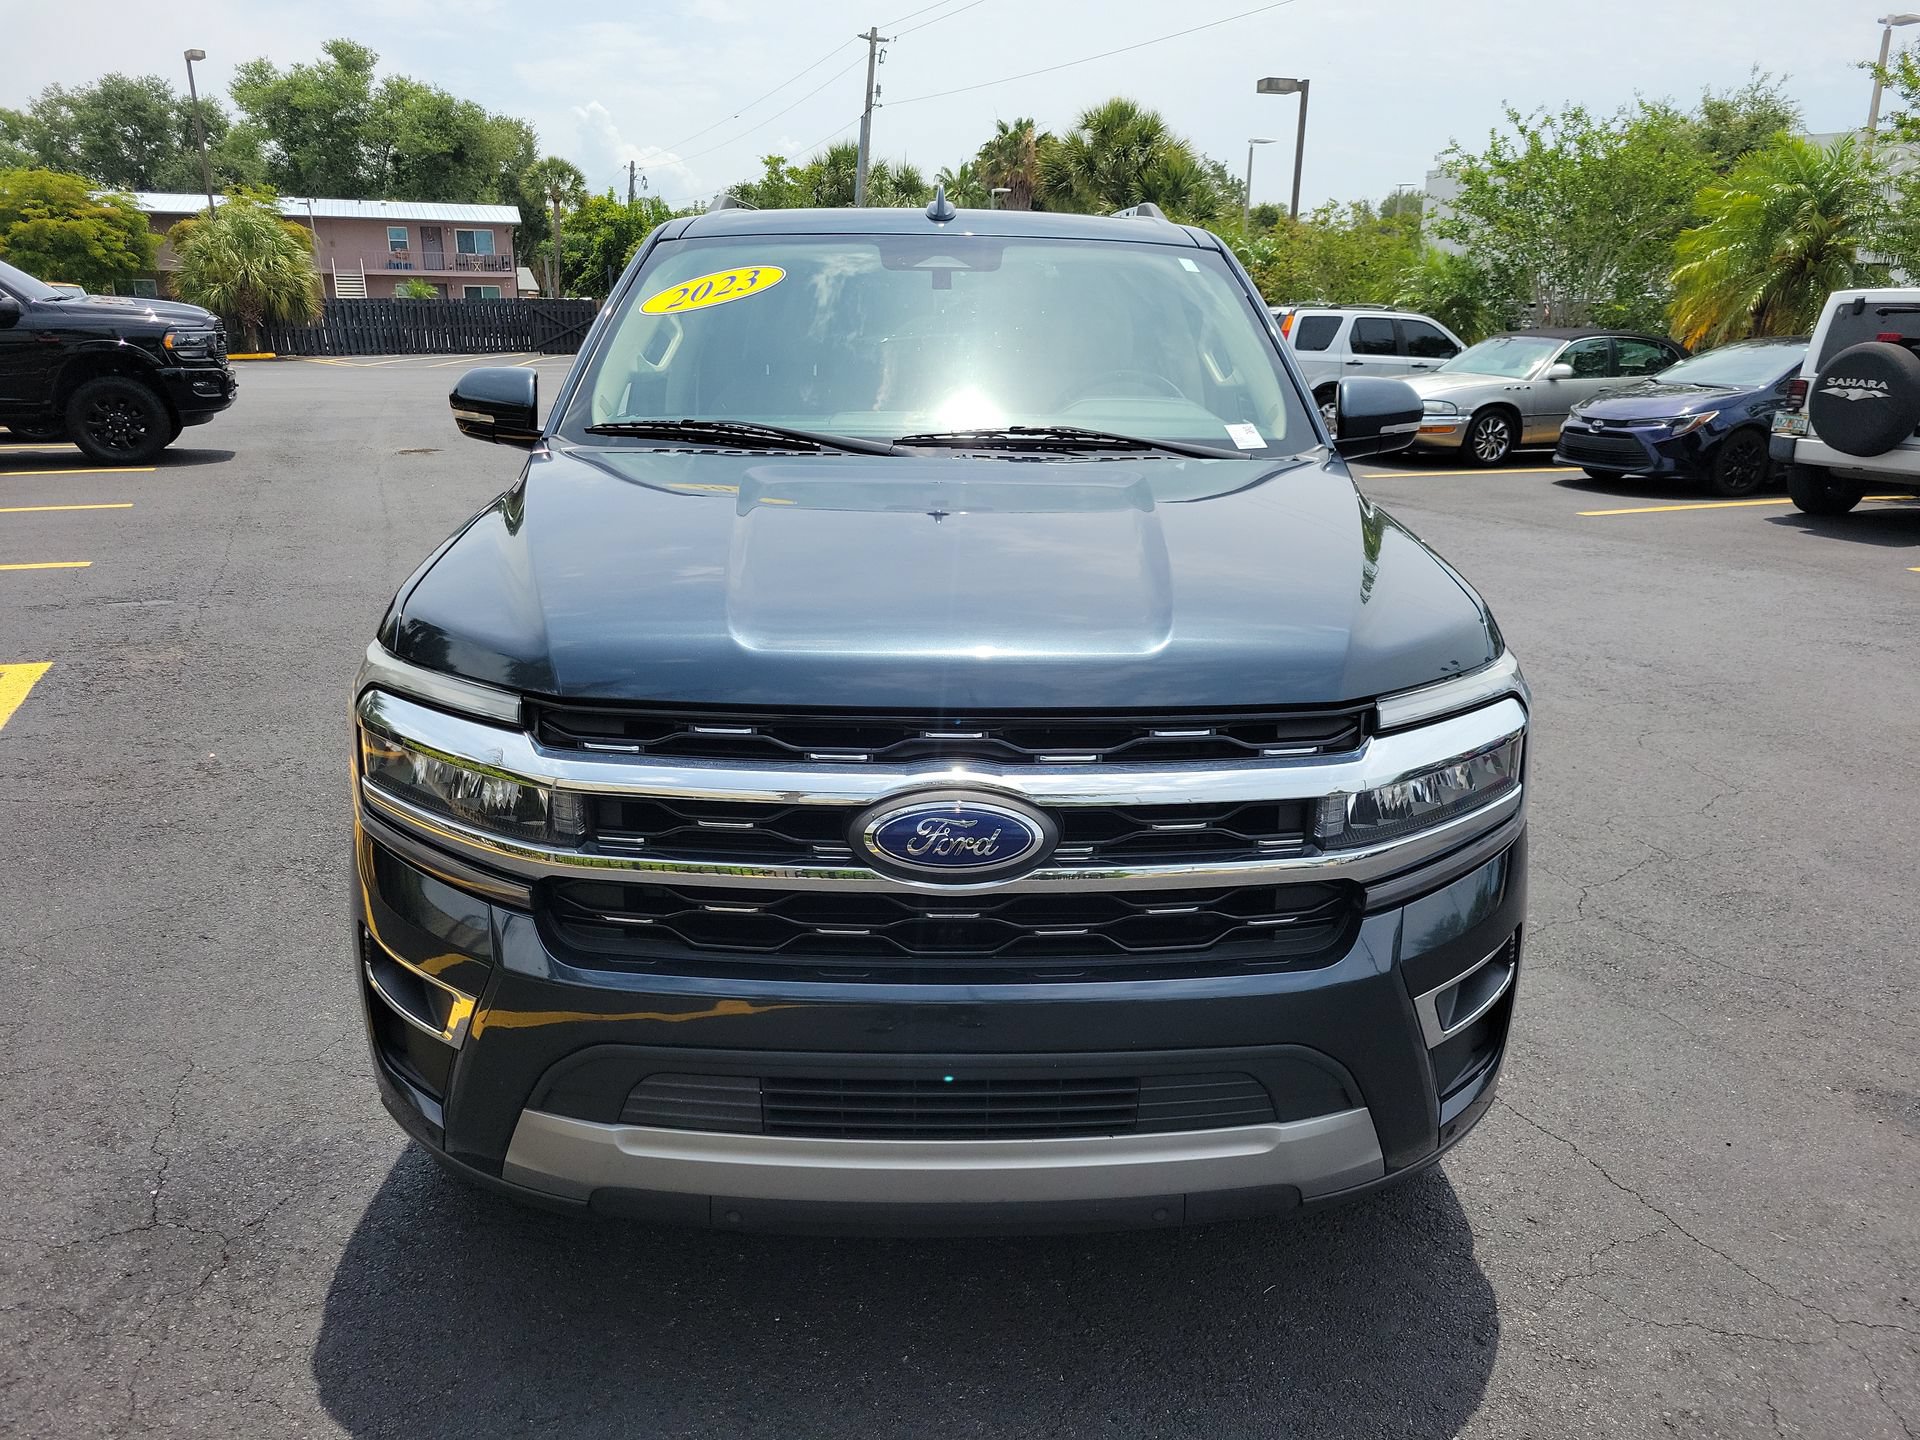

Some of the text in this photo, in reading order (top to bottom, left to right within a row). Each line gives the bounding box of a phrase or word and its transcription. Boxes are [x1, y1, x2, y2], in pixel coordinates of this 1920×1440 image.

[665, 269, 761, 310] 2023
[1826, 377, 1889, 390] SAHARA
[906, 817, 1002, 857] Ford
